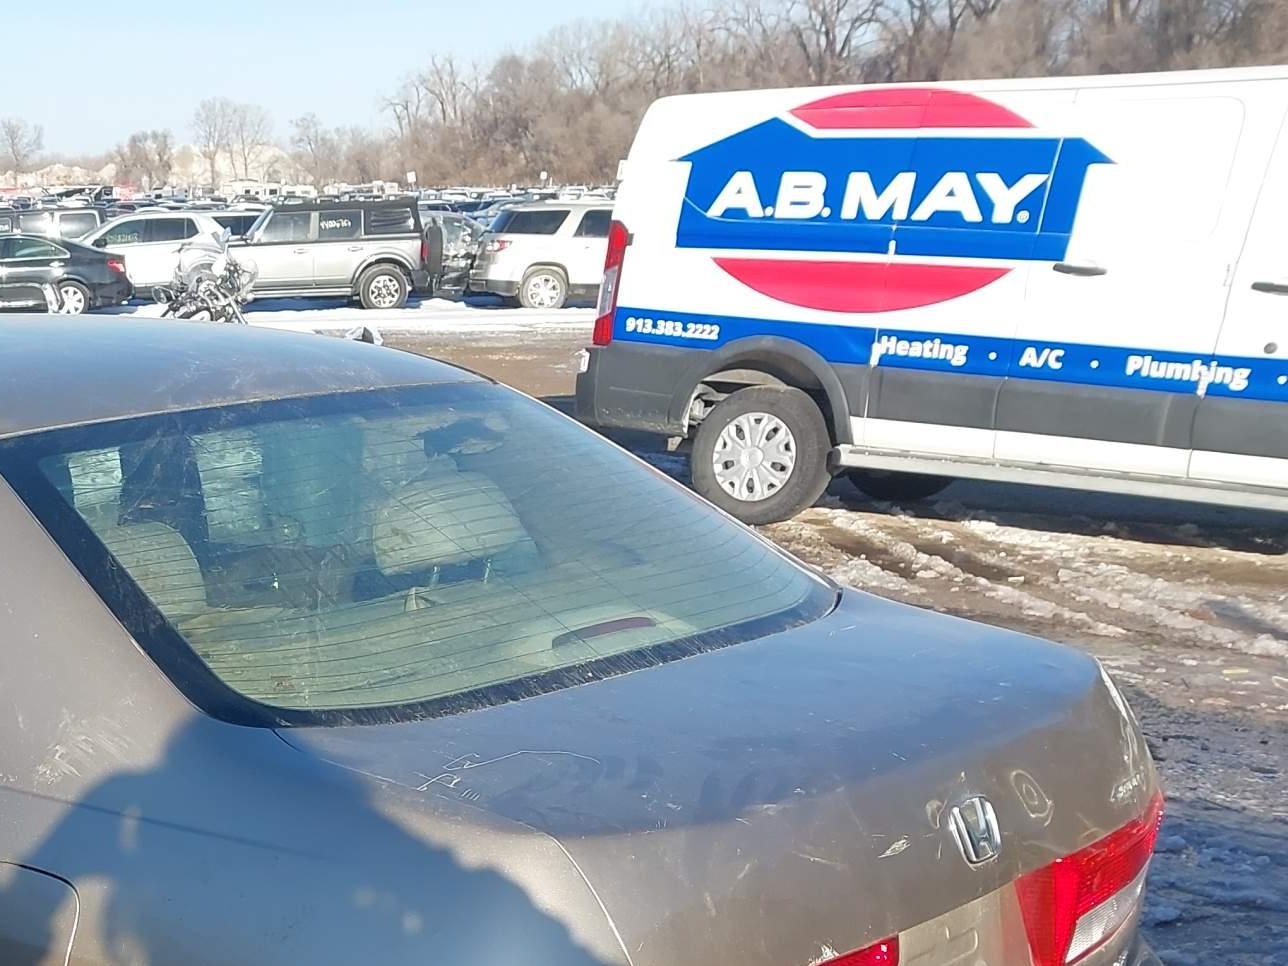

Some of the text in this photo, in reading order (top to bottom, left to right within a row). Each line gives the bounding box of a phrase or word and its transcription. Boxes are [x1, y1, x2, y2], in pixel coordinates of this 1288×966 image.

[706, 171, 832, 220] A.B.
[625, 316, 720, 341] 913.383.2222
[879, 335, 1253, 392] Heating A/C Plumbing
